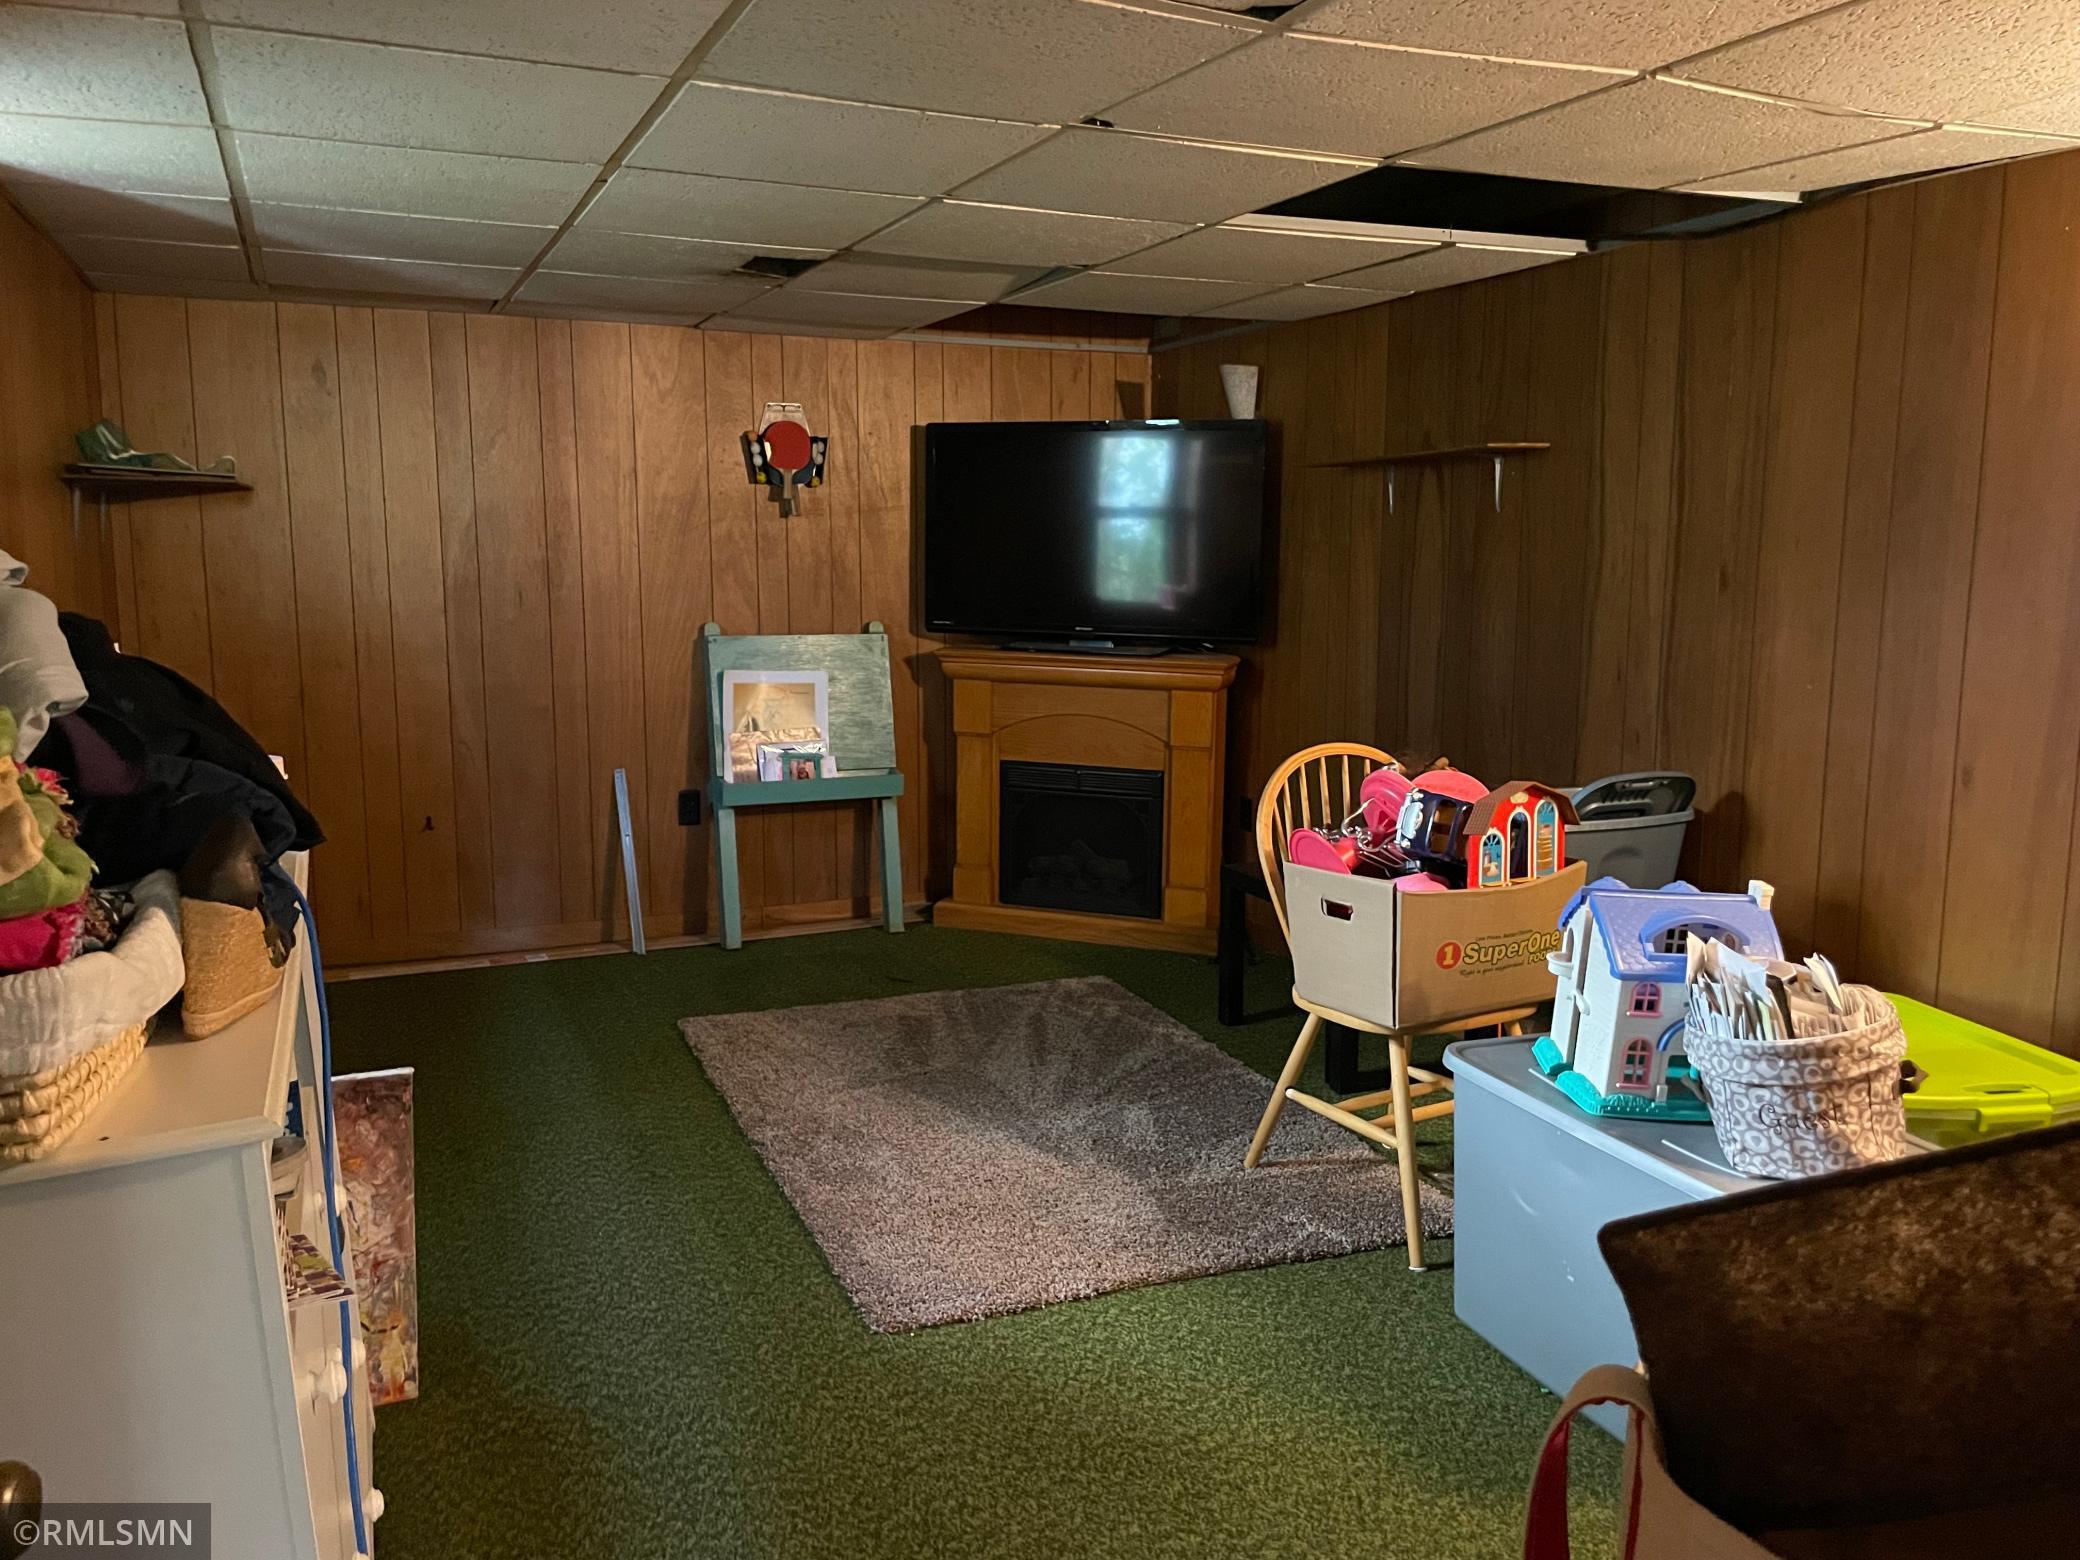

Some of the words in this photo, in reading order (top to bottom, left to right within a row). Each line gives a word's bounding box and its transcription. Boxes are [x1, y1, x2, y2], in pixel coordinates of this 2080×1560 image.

[1442, 945, 1455, 966] 1
[1462, 929, 1560, 965] SuperOne
[1528, 949, 1553, 964] FOO
[1759, 1103, 1843, 1135] Guest
